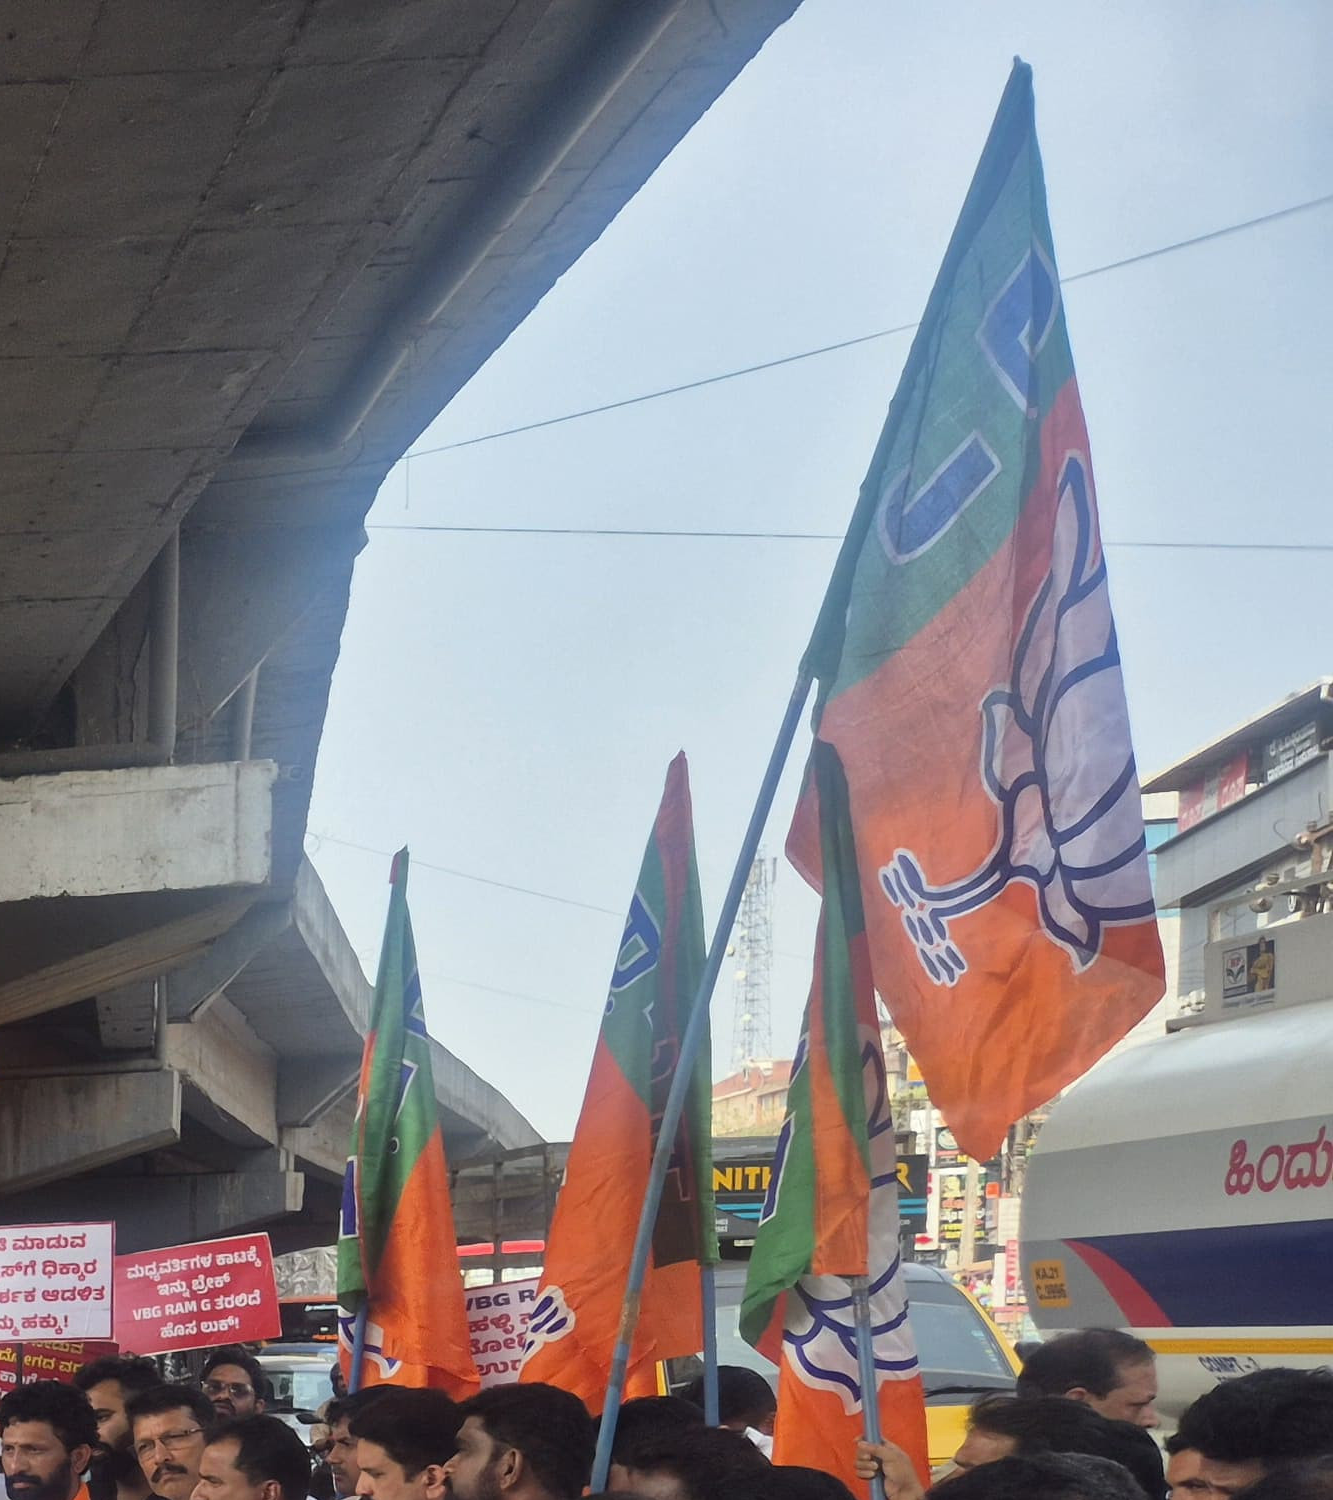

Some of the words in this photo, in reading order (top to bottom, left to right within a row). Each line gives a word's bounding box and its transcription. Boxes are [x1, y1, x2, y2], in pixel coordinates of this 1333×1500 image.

[12, 1233, 87, 1251] ಮಾಡುವ
[42, 1259, 97, 1283] ಧಿಕ್ಕಾರ
[41, 1284, 105, 1302] ಆಡಳಿತ
[157, 1280, 190, 1299] ಇನ್ನು
[192, 1273, 231, 1291] ಬ್ರೇಕ್
[132, 1304, 162, 1322] VBG
[165, 1299, 197, 1317] RAM
[200, 1297, 211, 1312] G
[214, 1291, 261, 1310] ತರಲಿದೆ
[160, 1321, 197, 1339] ಹೊಸ
[200, 1316, 240, 1333] ಲುಕ್!
